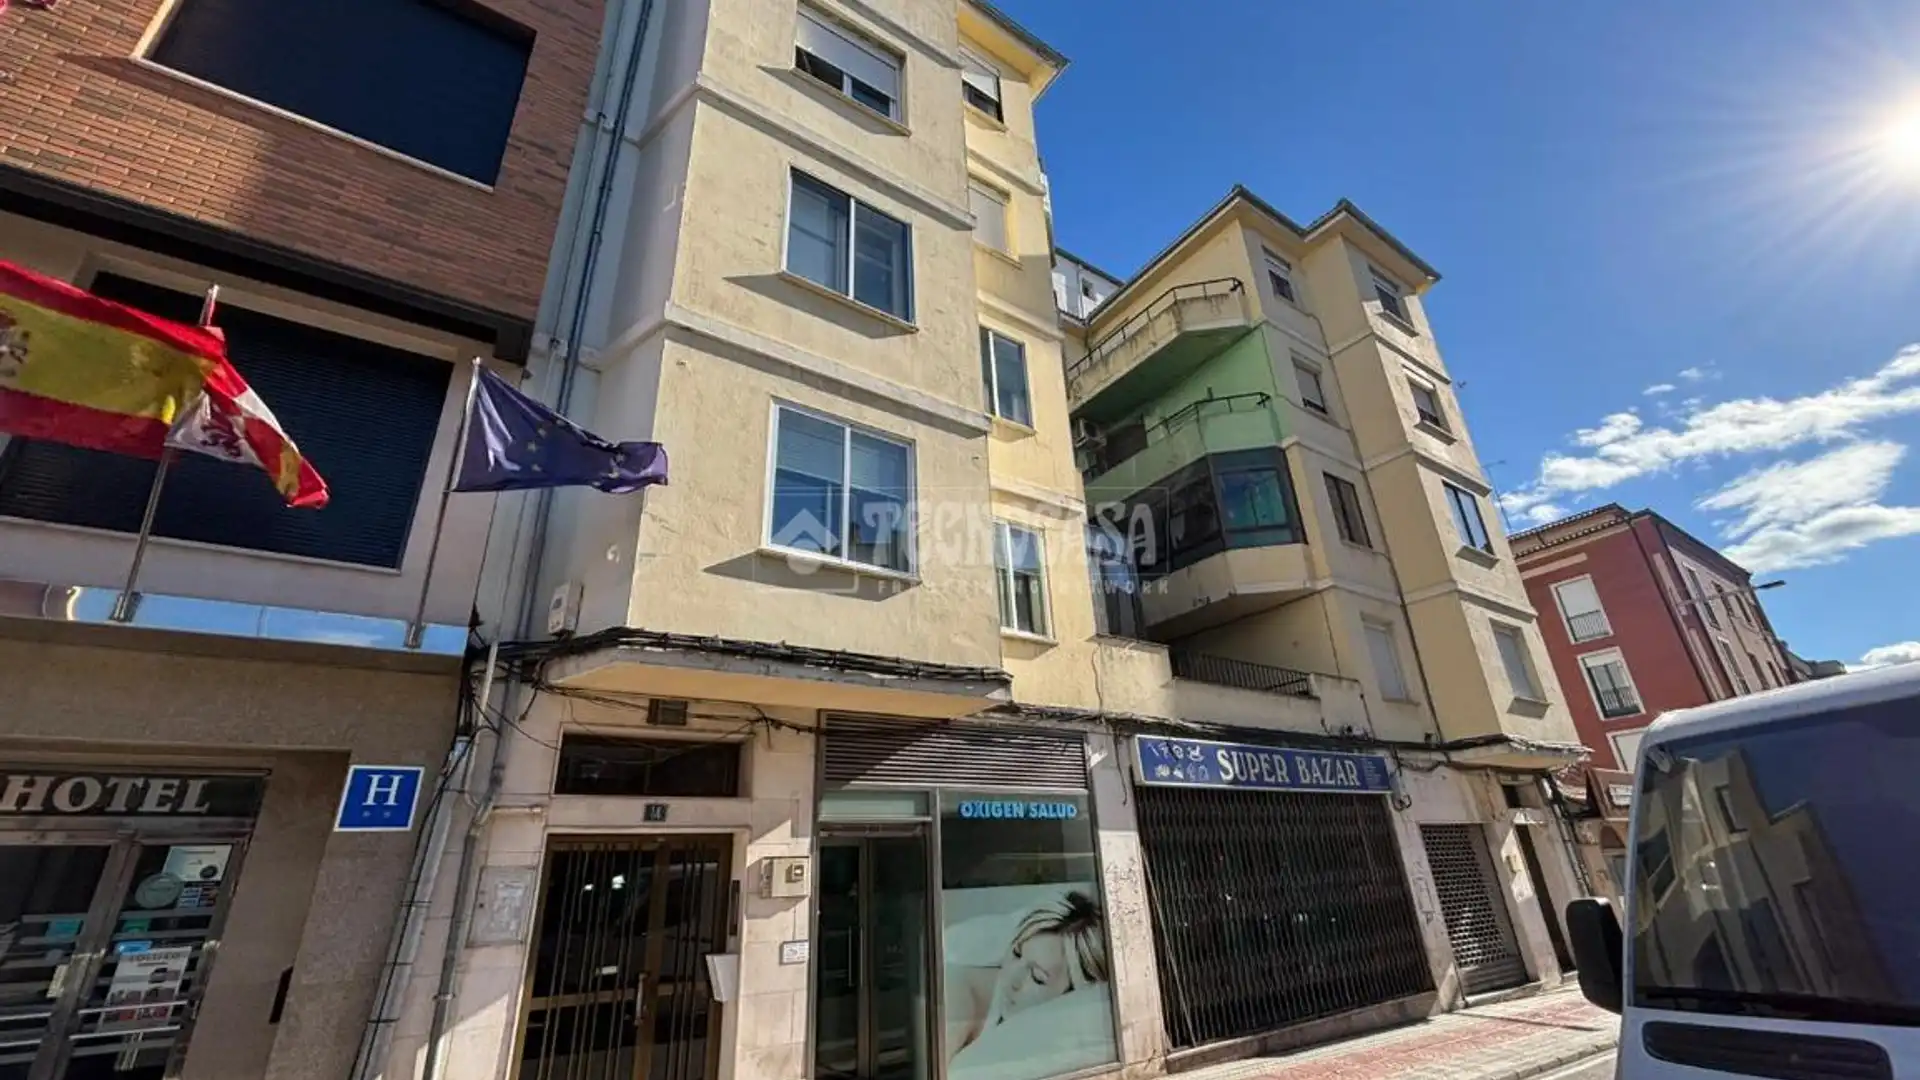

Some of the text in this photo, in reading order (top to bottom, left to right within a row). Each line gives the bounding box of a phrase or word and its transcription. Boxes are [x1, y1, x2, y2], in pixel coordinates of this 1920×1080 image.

[1216, 749, 1290, 784] SUPER
[1295, 756, 1361, 787] BAZAR
[0, 775, 211, 814] HOTEL
[361, 774, 404, 806] H
[959, 800, 1079, 819] OXIGEN SALUD
